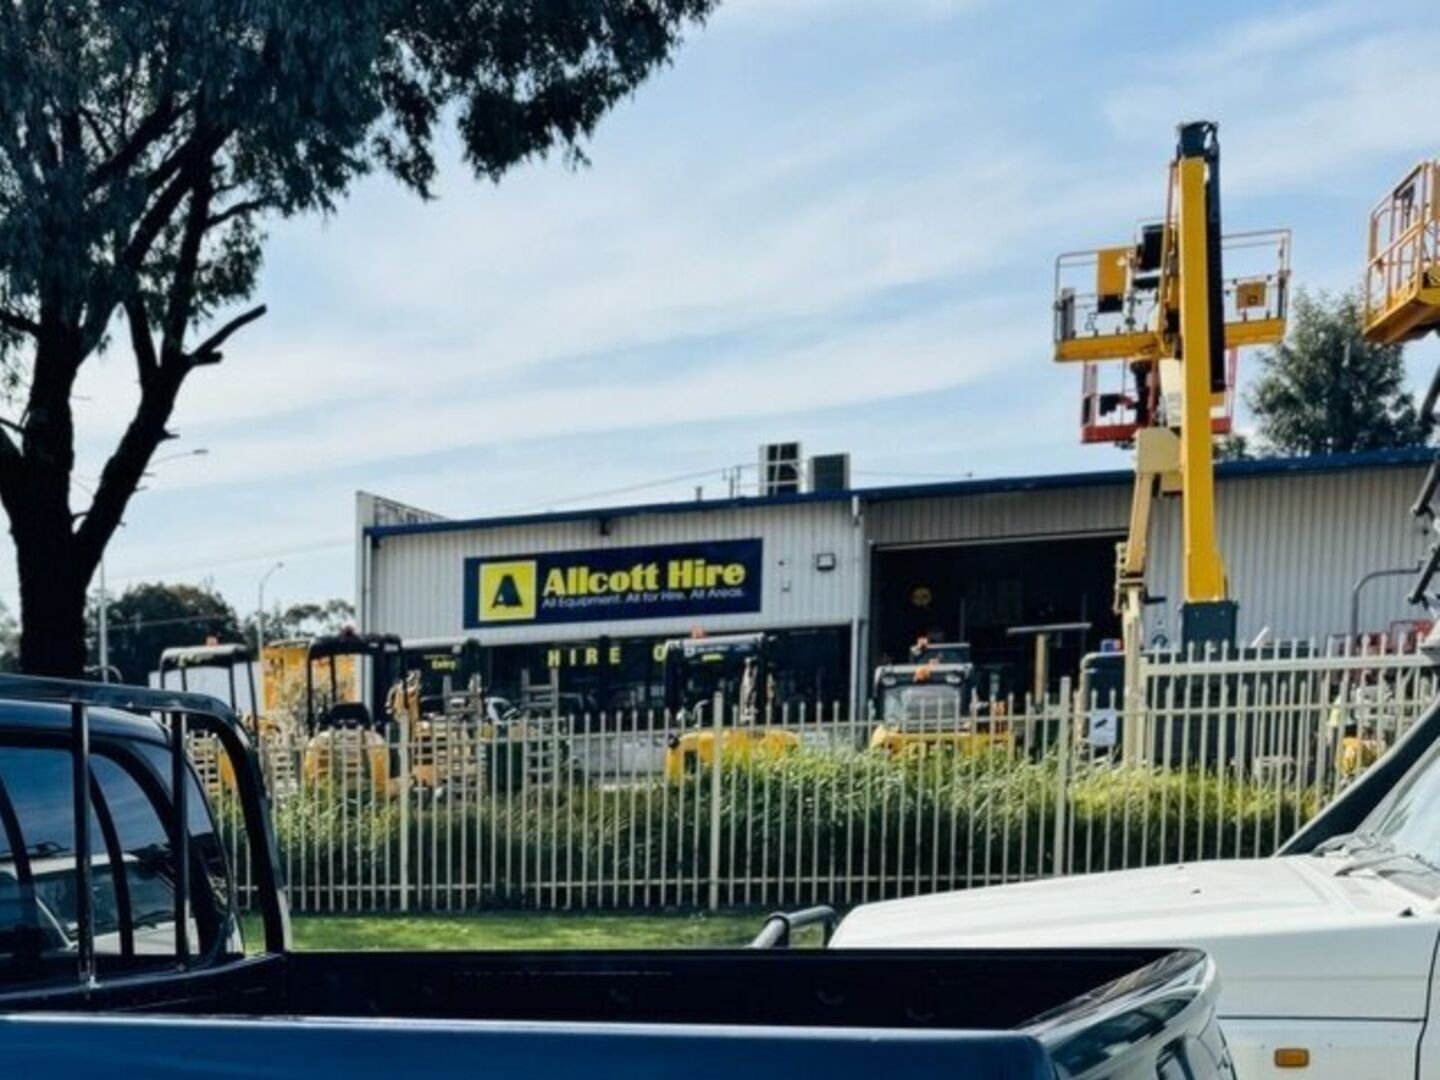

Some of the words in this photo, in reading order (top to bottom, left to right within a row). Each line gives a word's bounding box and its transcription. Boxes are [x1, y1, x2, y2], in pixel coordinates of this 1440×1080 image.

[542, 562, 660, 597] Allcott
[667, 558, 746, 590] Hire
[547, 646, 621, 668] HIRE
